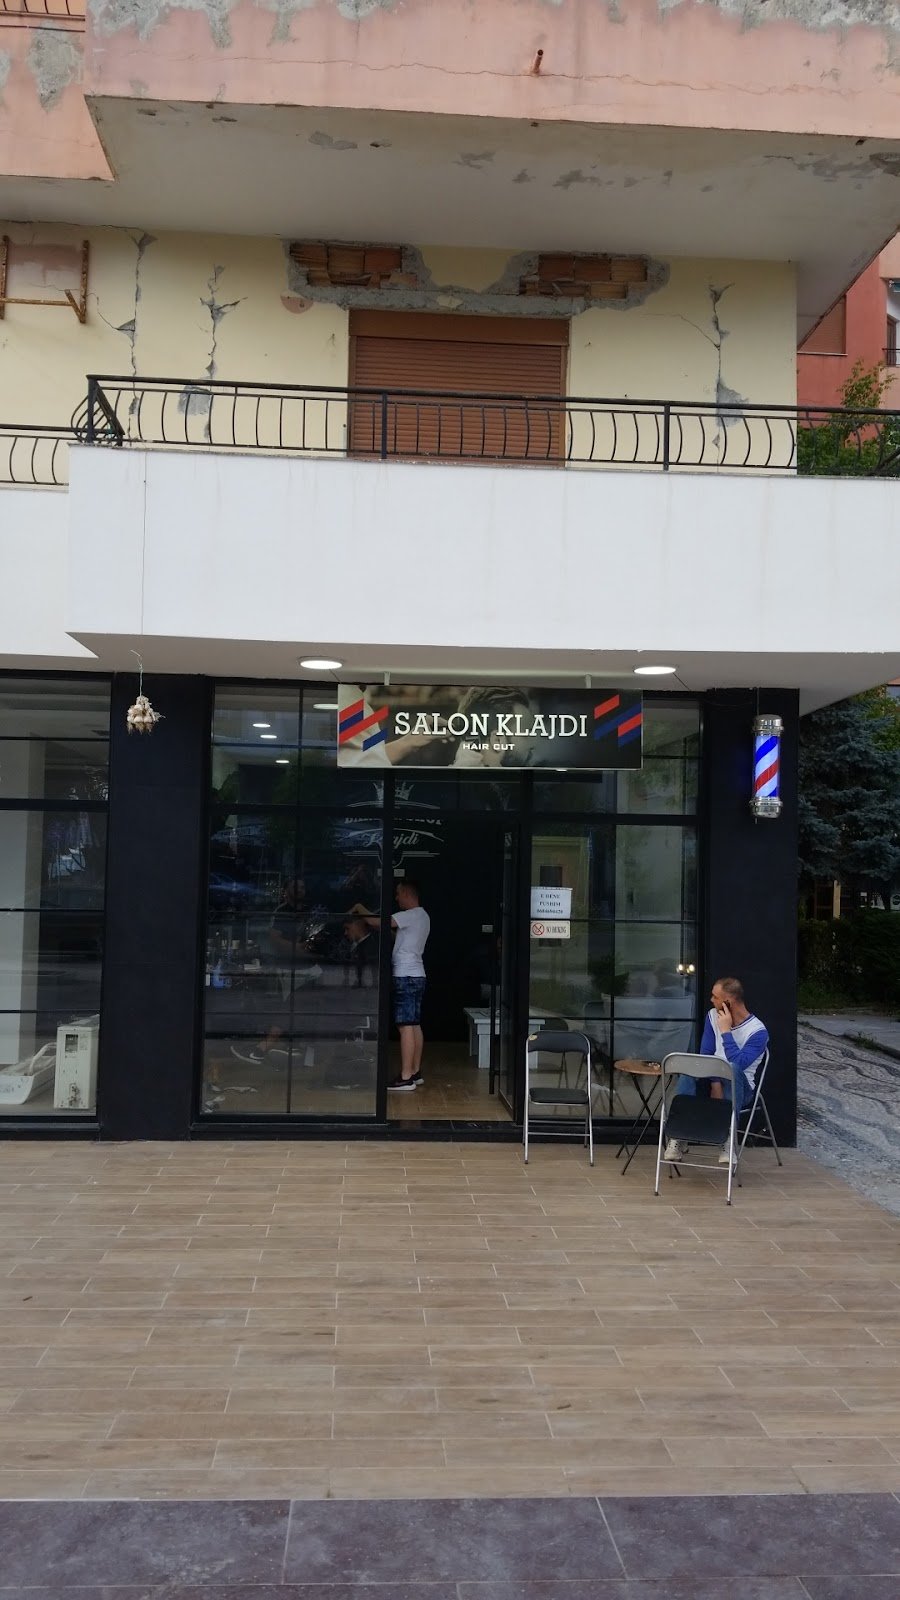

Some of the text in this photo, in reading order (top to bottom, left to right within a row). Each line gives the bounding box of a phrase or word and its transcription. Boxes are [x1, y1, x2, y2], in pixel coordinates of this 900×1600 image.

[394, 712, 588, 740] SALON KLAJDI
[462, 743, 515, 751] HAIR CUT
